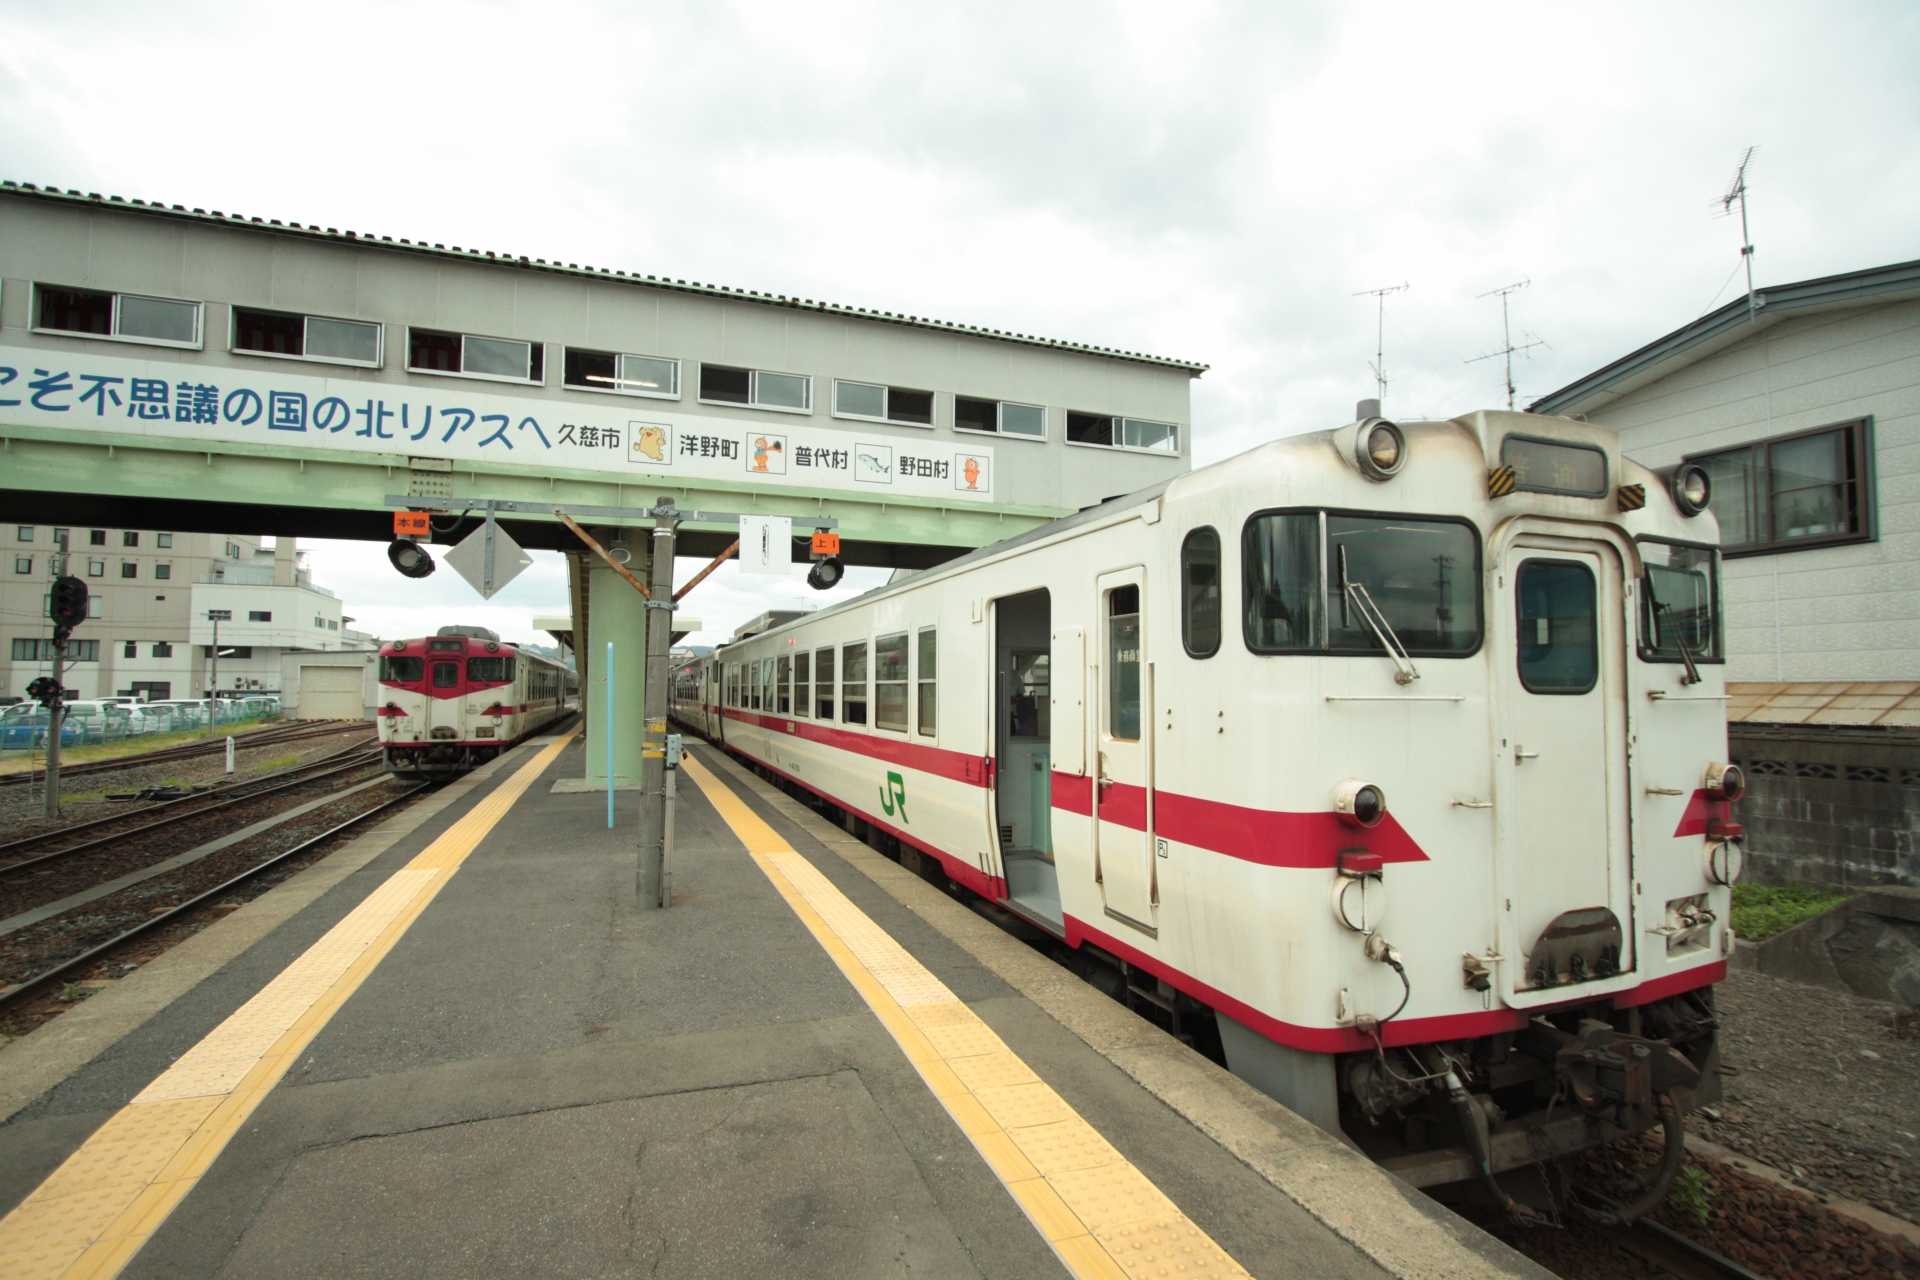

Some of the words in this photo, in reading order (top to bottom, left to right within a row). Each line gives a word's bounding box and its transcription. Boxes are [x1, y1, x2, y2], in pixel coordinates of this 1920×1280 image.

[558, 423, 621, 449] 久慈市
[680, 434, 739, 460] 洋野町
[795, 446, 849, 470] 普代村
[900, 456, 949, 479] 野田村
[397, 518, 426, 528] 本線
[879, 770, 909, 824] JR
